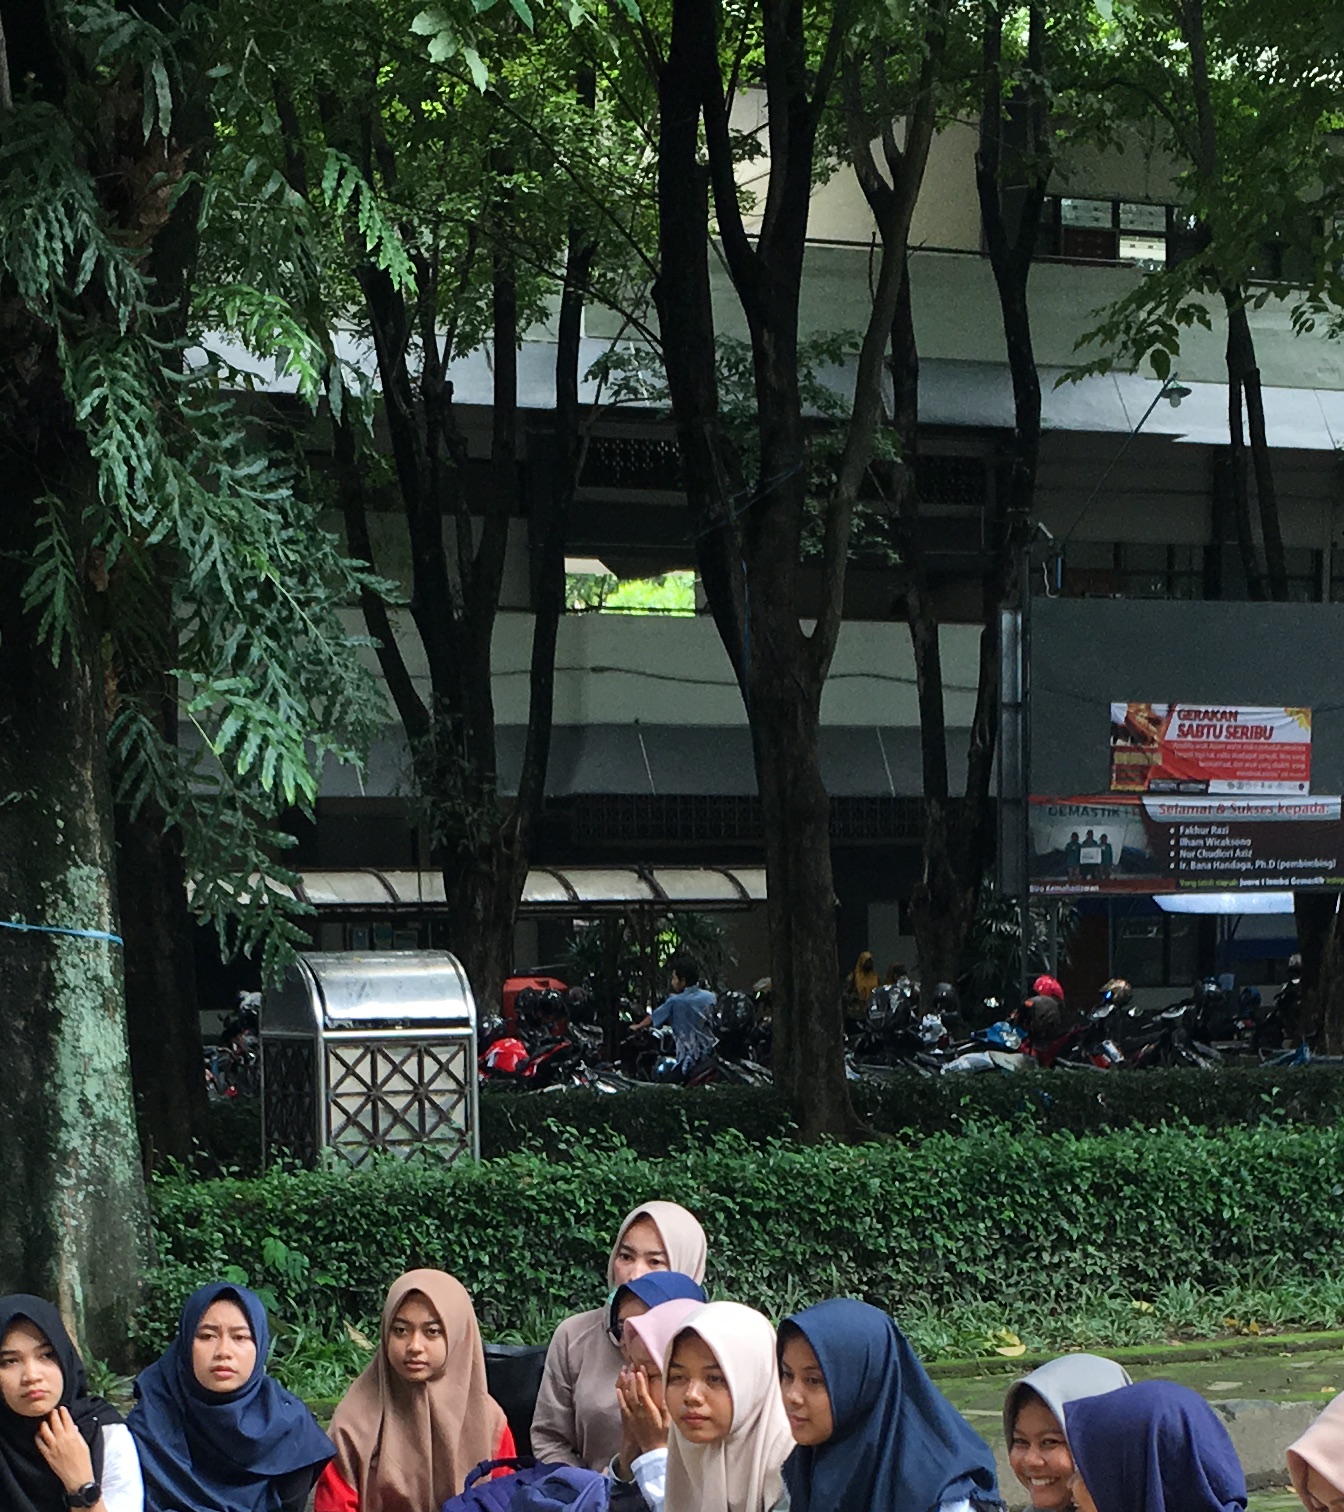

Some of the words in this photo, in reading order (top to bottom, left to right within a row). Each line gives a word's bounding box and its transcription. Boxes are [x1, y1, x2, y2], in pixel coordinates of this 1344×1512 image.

[1177, 709, 1239, 722] GERAKAN
[1176, 723, 1223, 738] SABTU
[1225, 725, 1275, 740] SERIBU
[1158, 803, 1212, 815] Selamat
[1230, 802, 1274, 815] Sukses
[1210, 825, 1229, 835] Razi
[1205, 837, 1252, 847] Wicaksono
[1179, 849, 1195, 858] Nur
[1235, 849, 1253, 858] Aziz
[1255, 859, 1275, 869] Ph.D
